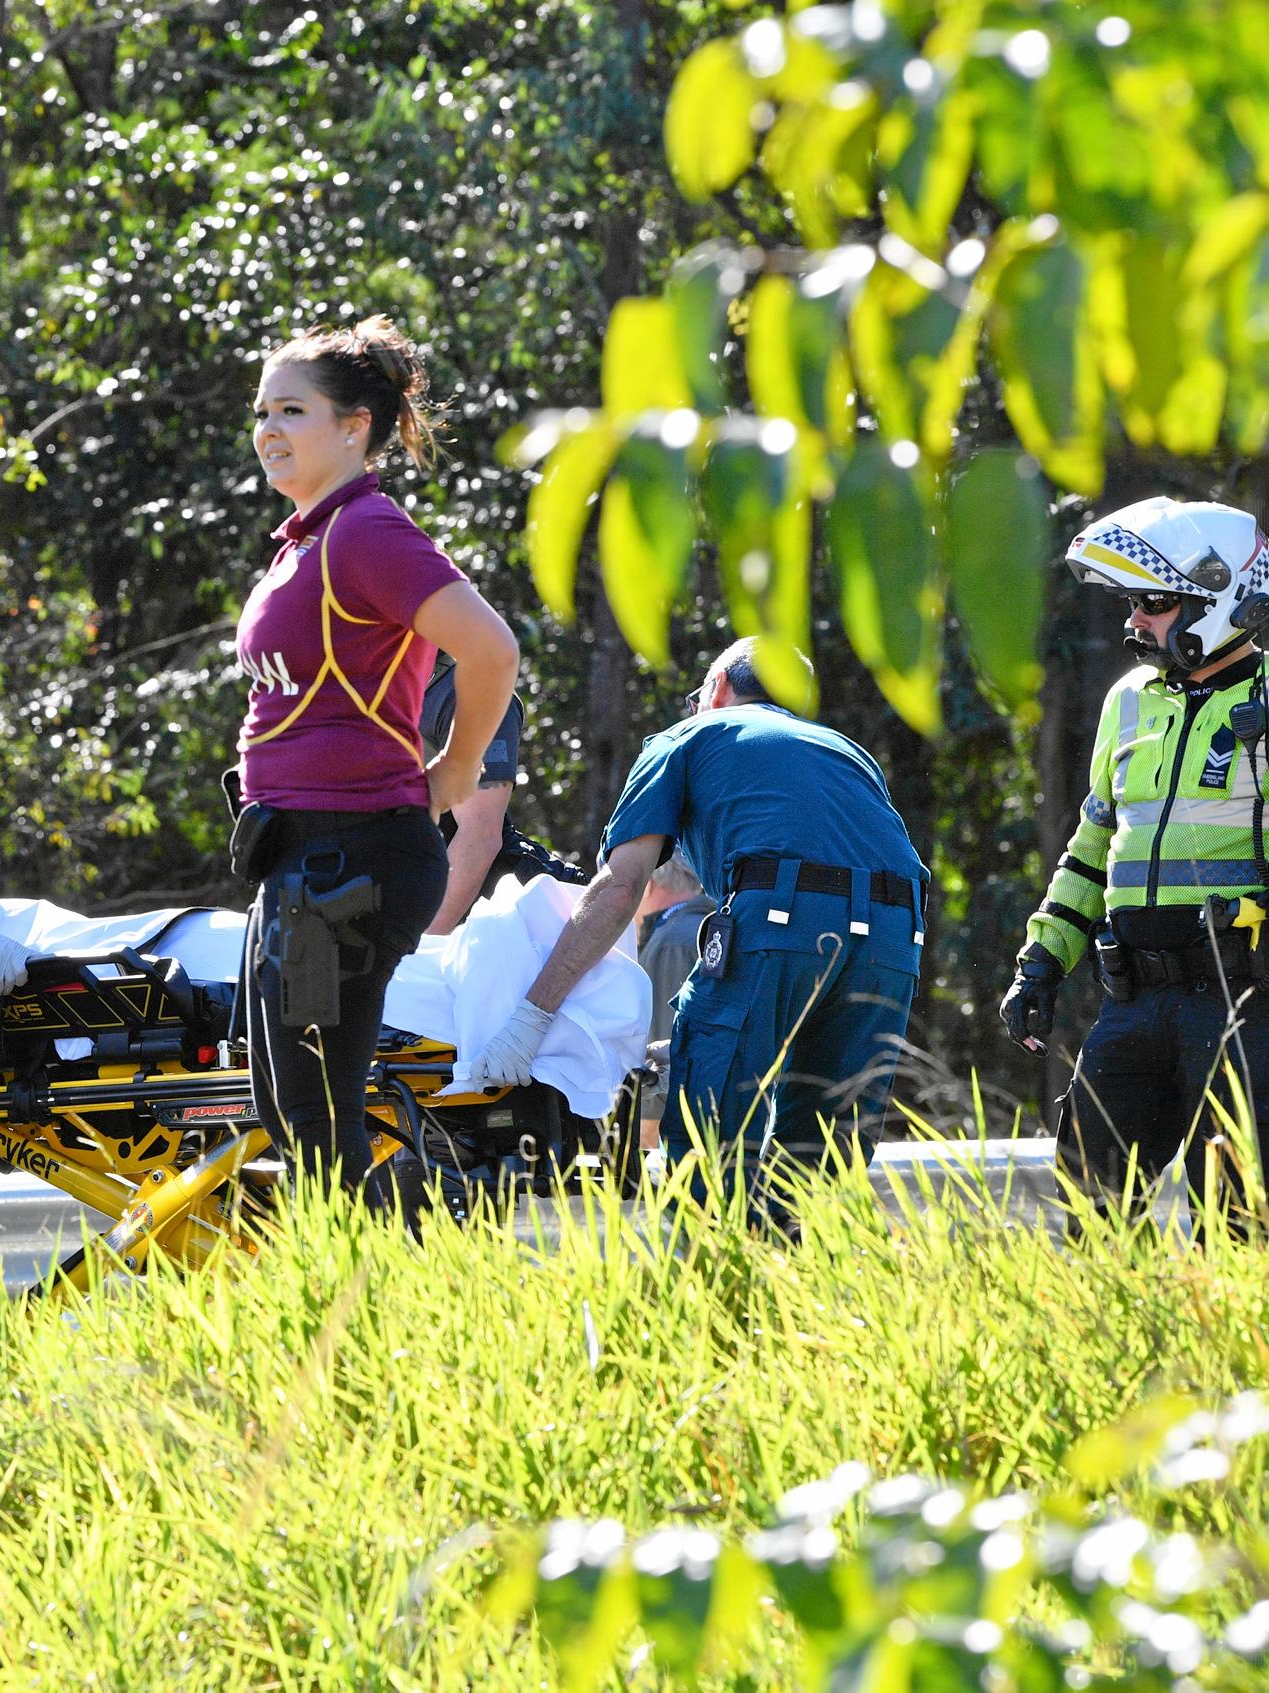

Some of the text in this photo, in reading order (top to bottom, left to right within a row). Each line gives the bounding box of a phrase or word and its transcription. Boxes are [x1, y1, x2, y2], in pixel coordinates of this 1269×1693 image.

[1189, 687, 1213, 697] POLIC
[2, 1003, 43, 1020] XPS
[182, 1103, 245, 1121] power
